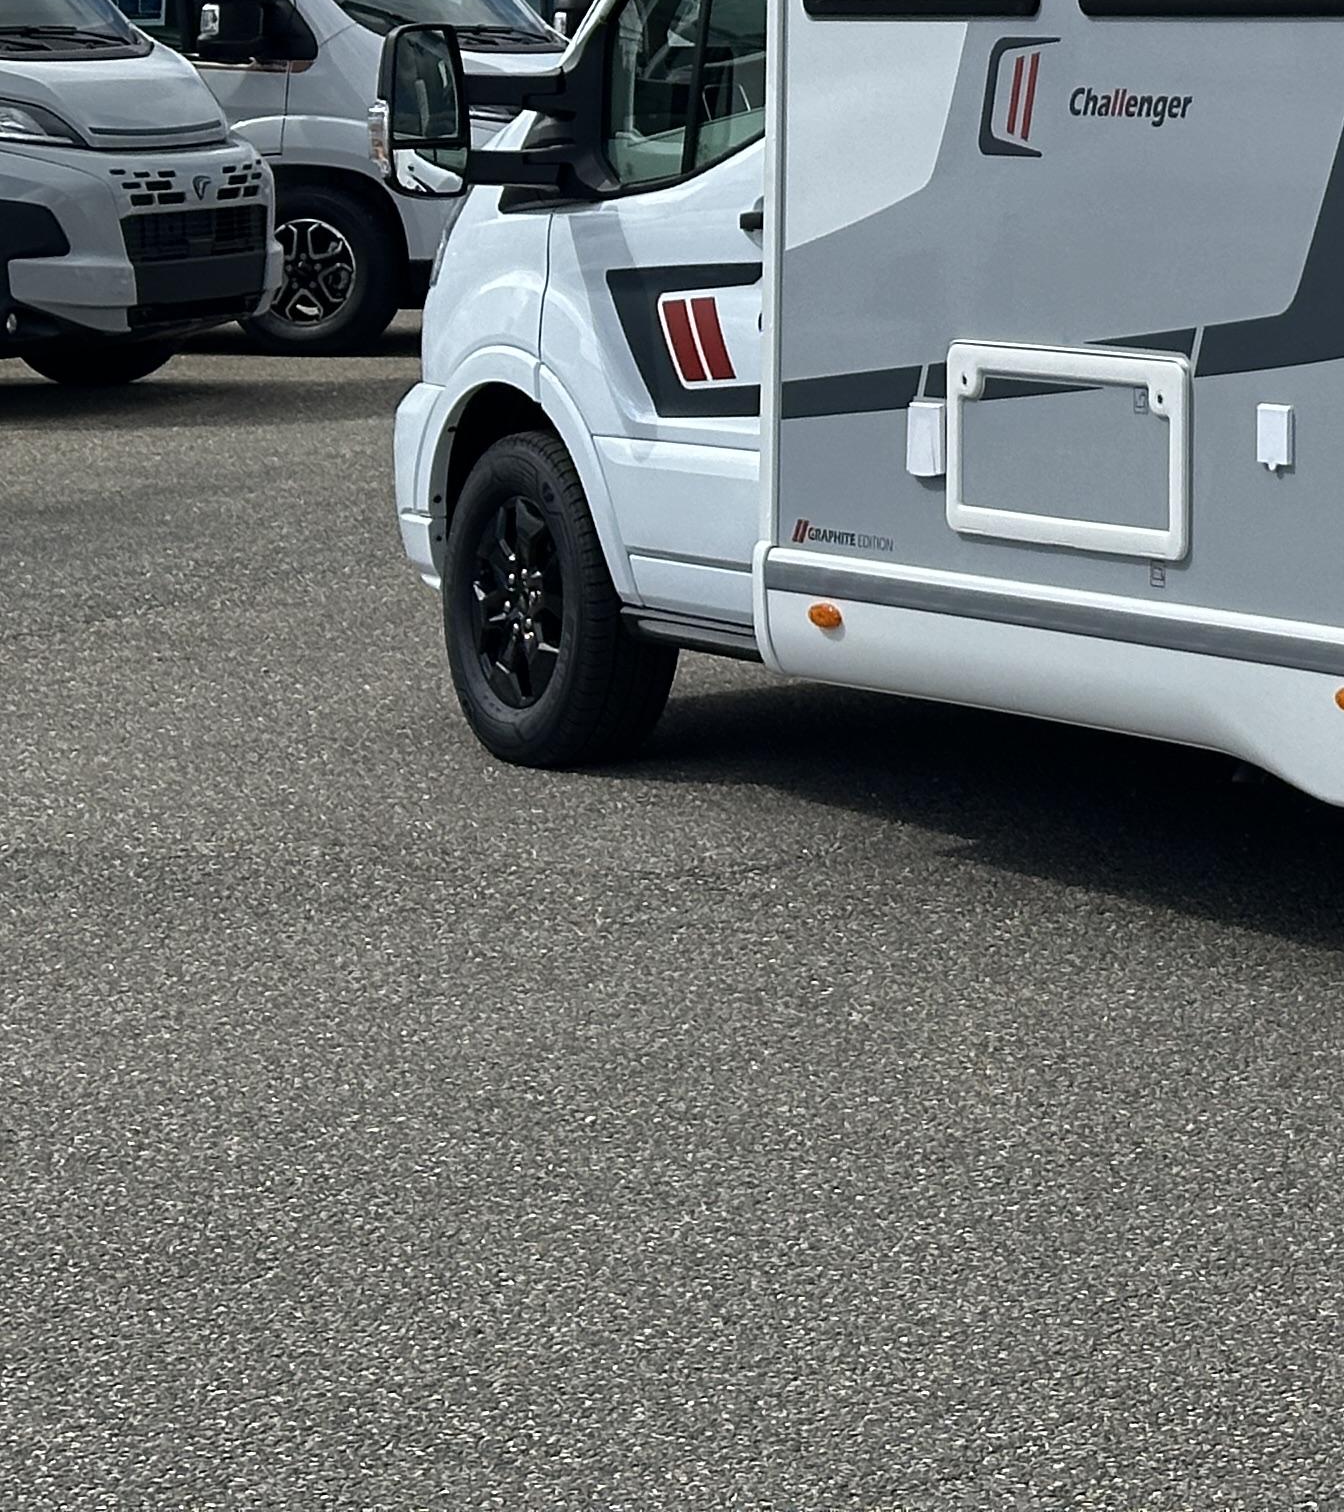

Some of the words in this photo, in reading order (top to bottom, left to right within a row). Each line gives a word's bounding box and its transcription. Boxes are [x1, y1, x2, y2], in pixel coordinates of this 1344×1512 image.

[1069, 87, 1193, 127] Challenger
[808, 527, 857, 547] GRAPHITE
[857, 534, 895, 552] EDITION
